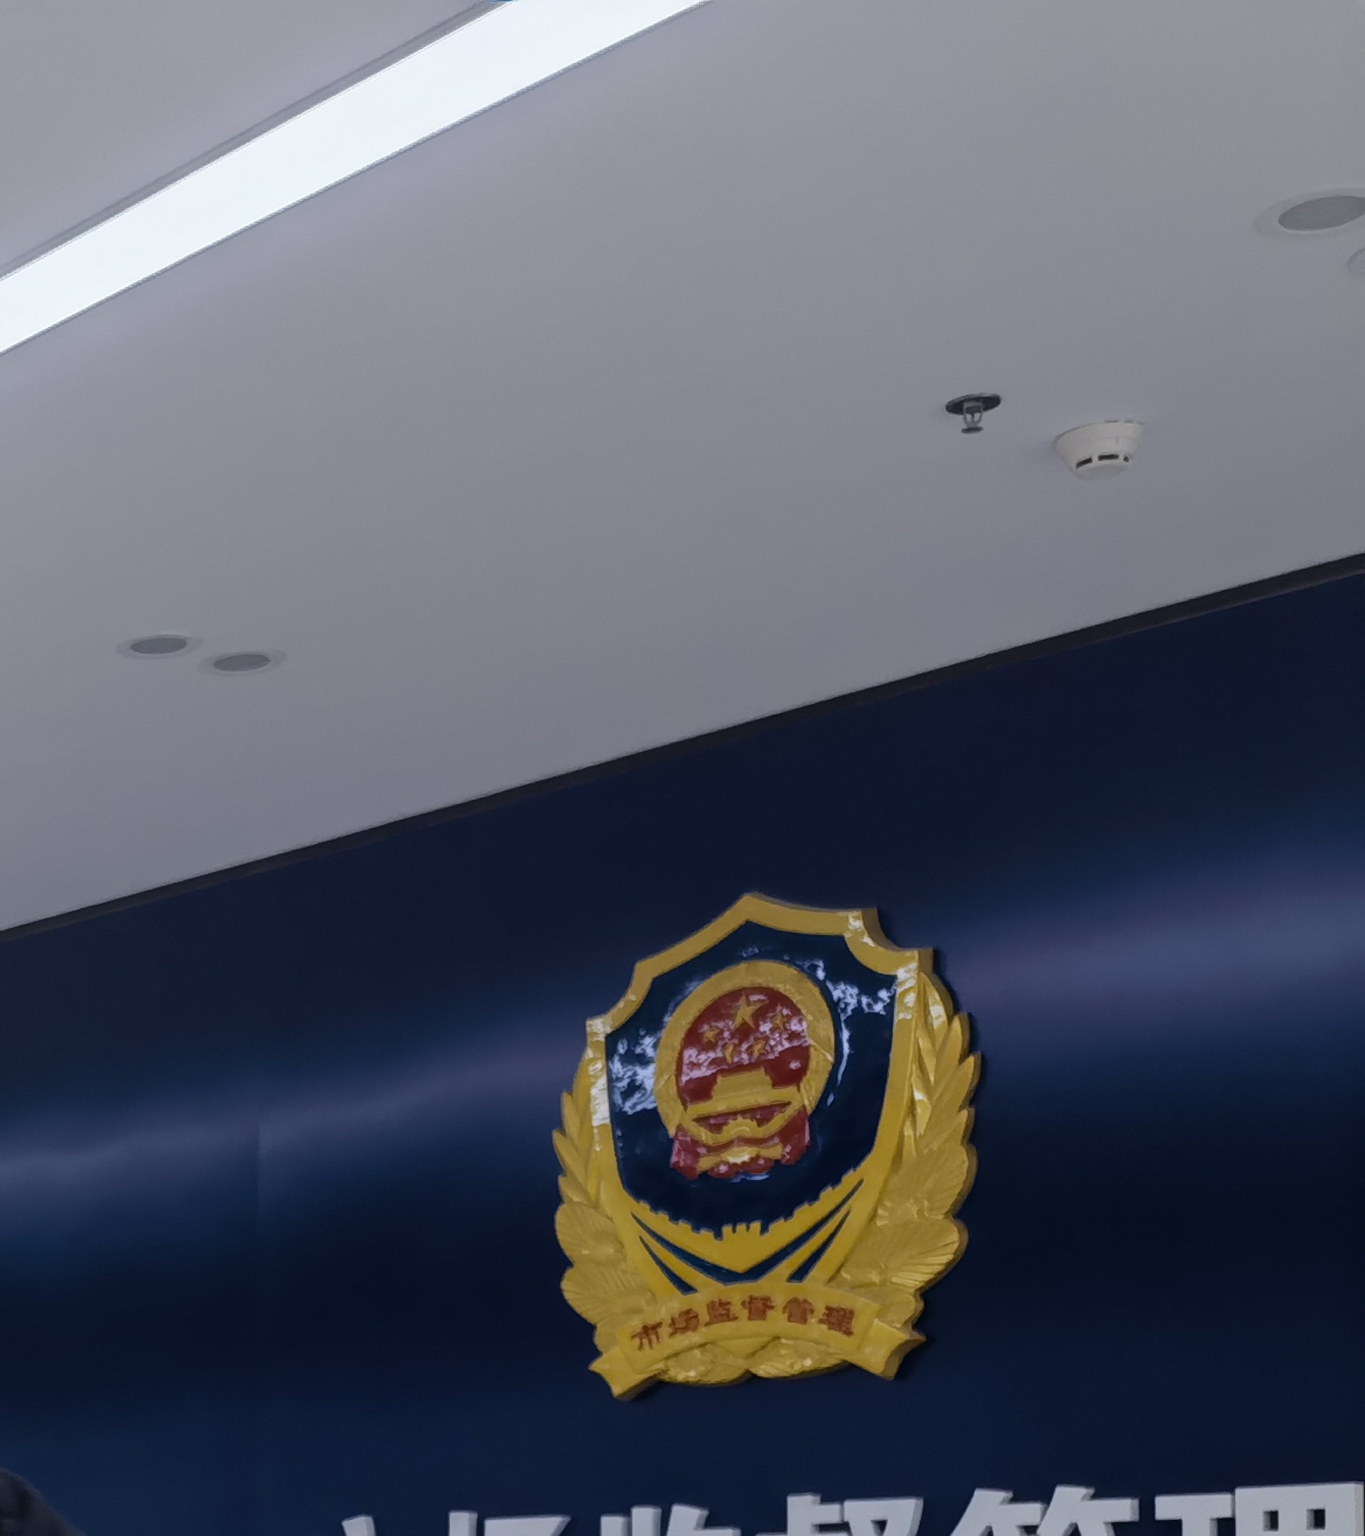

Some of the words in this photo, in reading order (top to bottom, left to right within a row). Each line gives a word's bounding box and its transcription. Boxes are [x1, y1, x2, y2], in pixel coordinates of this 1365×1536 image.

[632, 1294, 856, 1351] 市场监督管理
